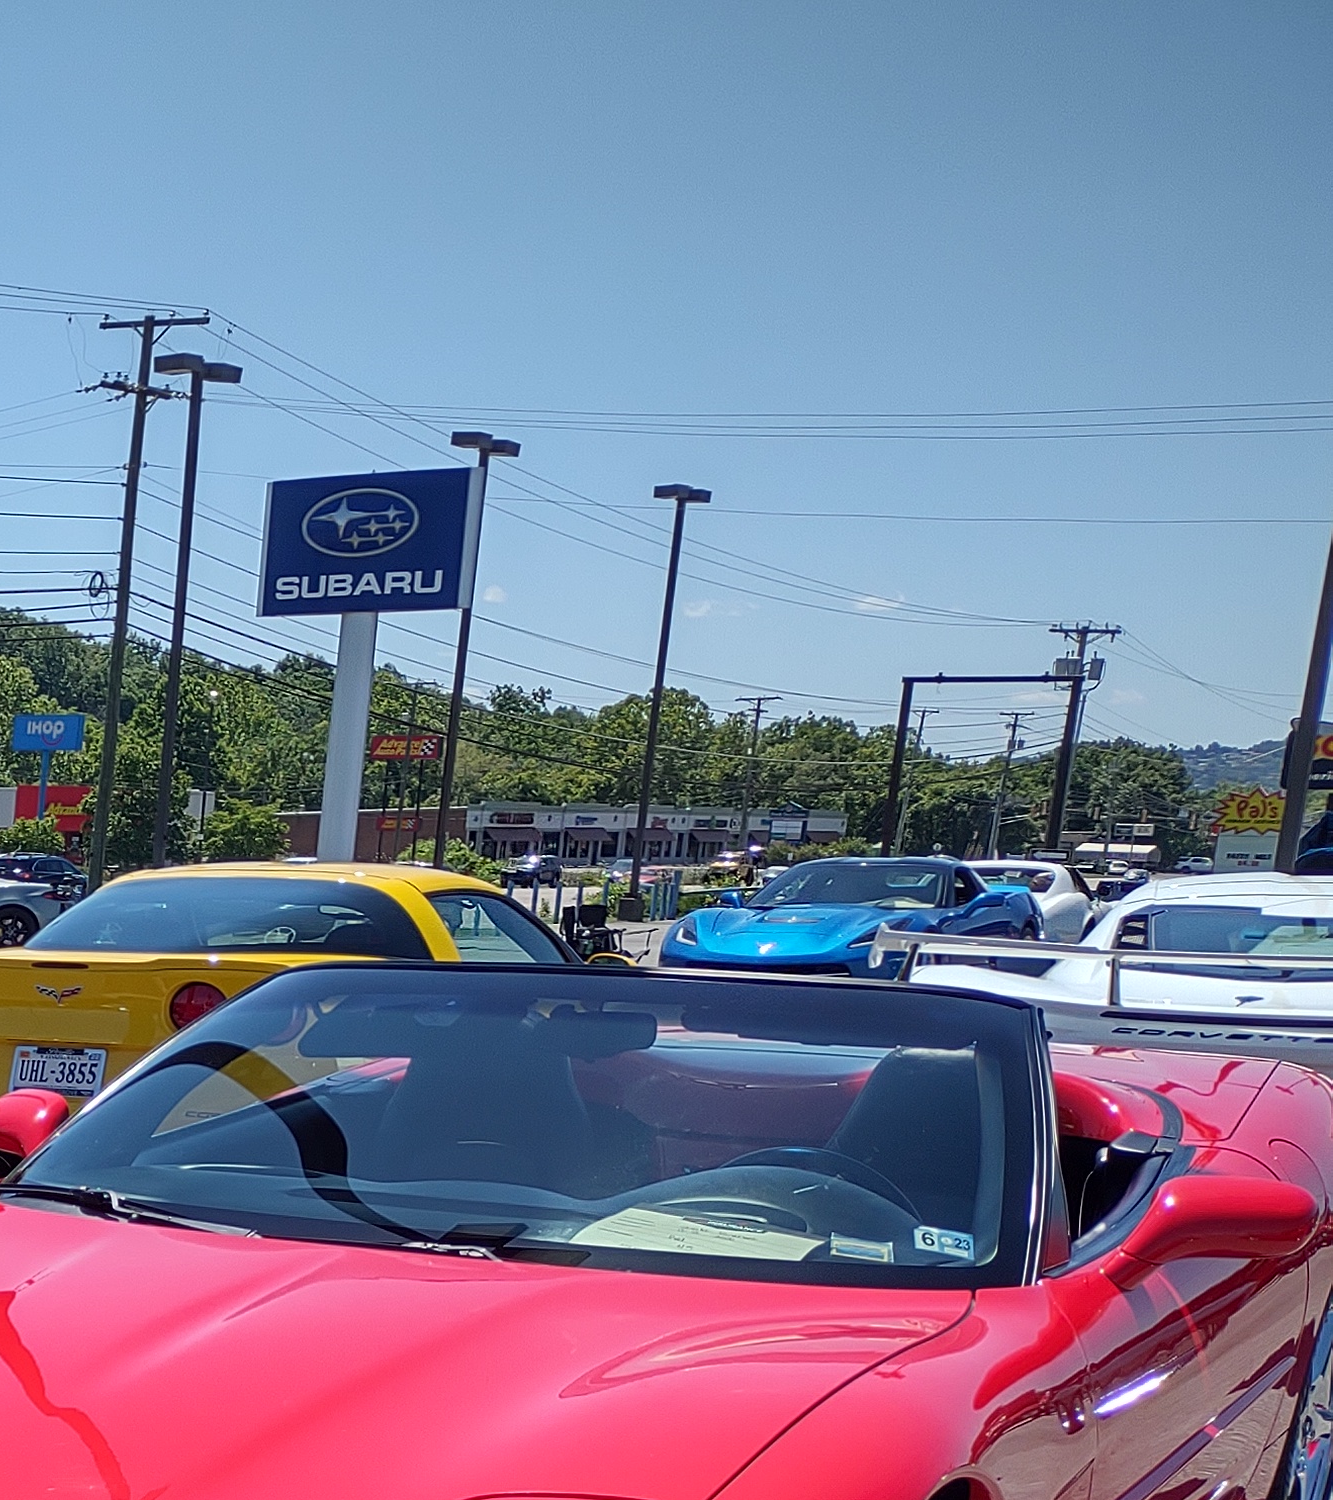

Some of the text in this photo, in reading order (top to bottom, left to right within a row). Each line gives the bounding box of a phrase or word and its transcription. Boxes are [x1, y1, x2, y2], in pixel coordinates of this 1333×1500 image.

[274, 569, 444, 601] SUBARU
[395, 748, 421, 756] Pats
[19, 1059, 99, 1085] UHL-3855
[921, 1232, 971, 1251] 6 23
